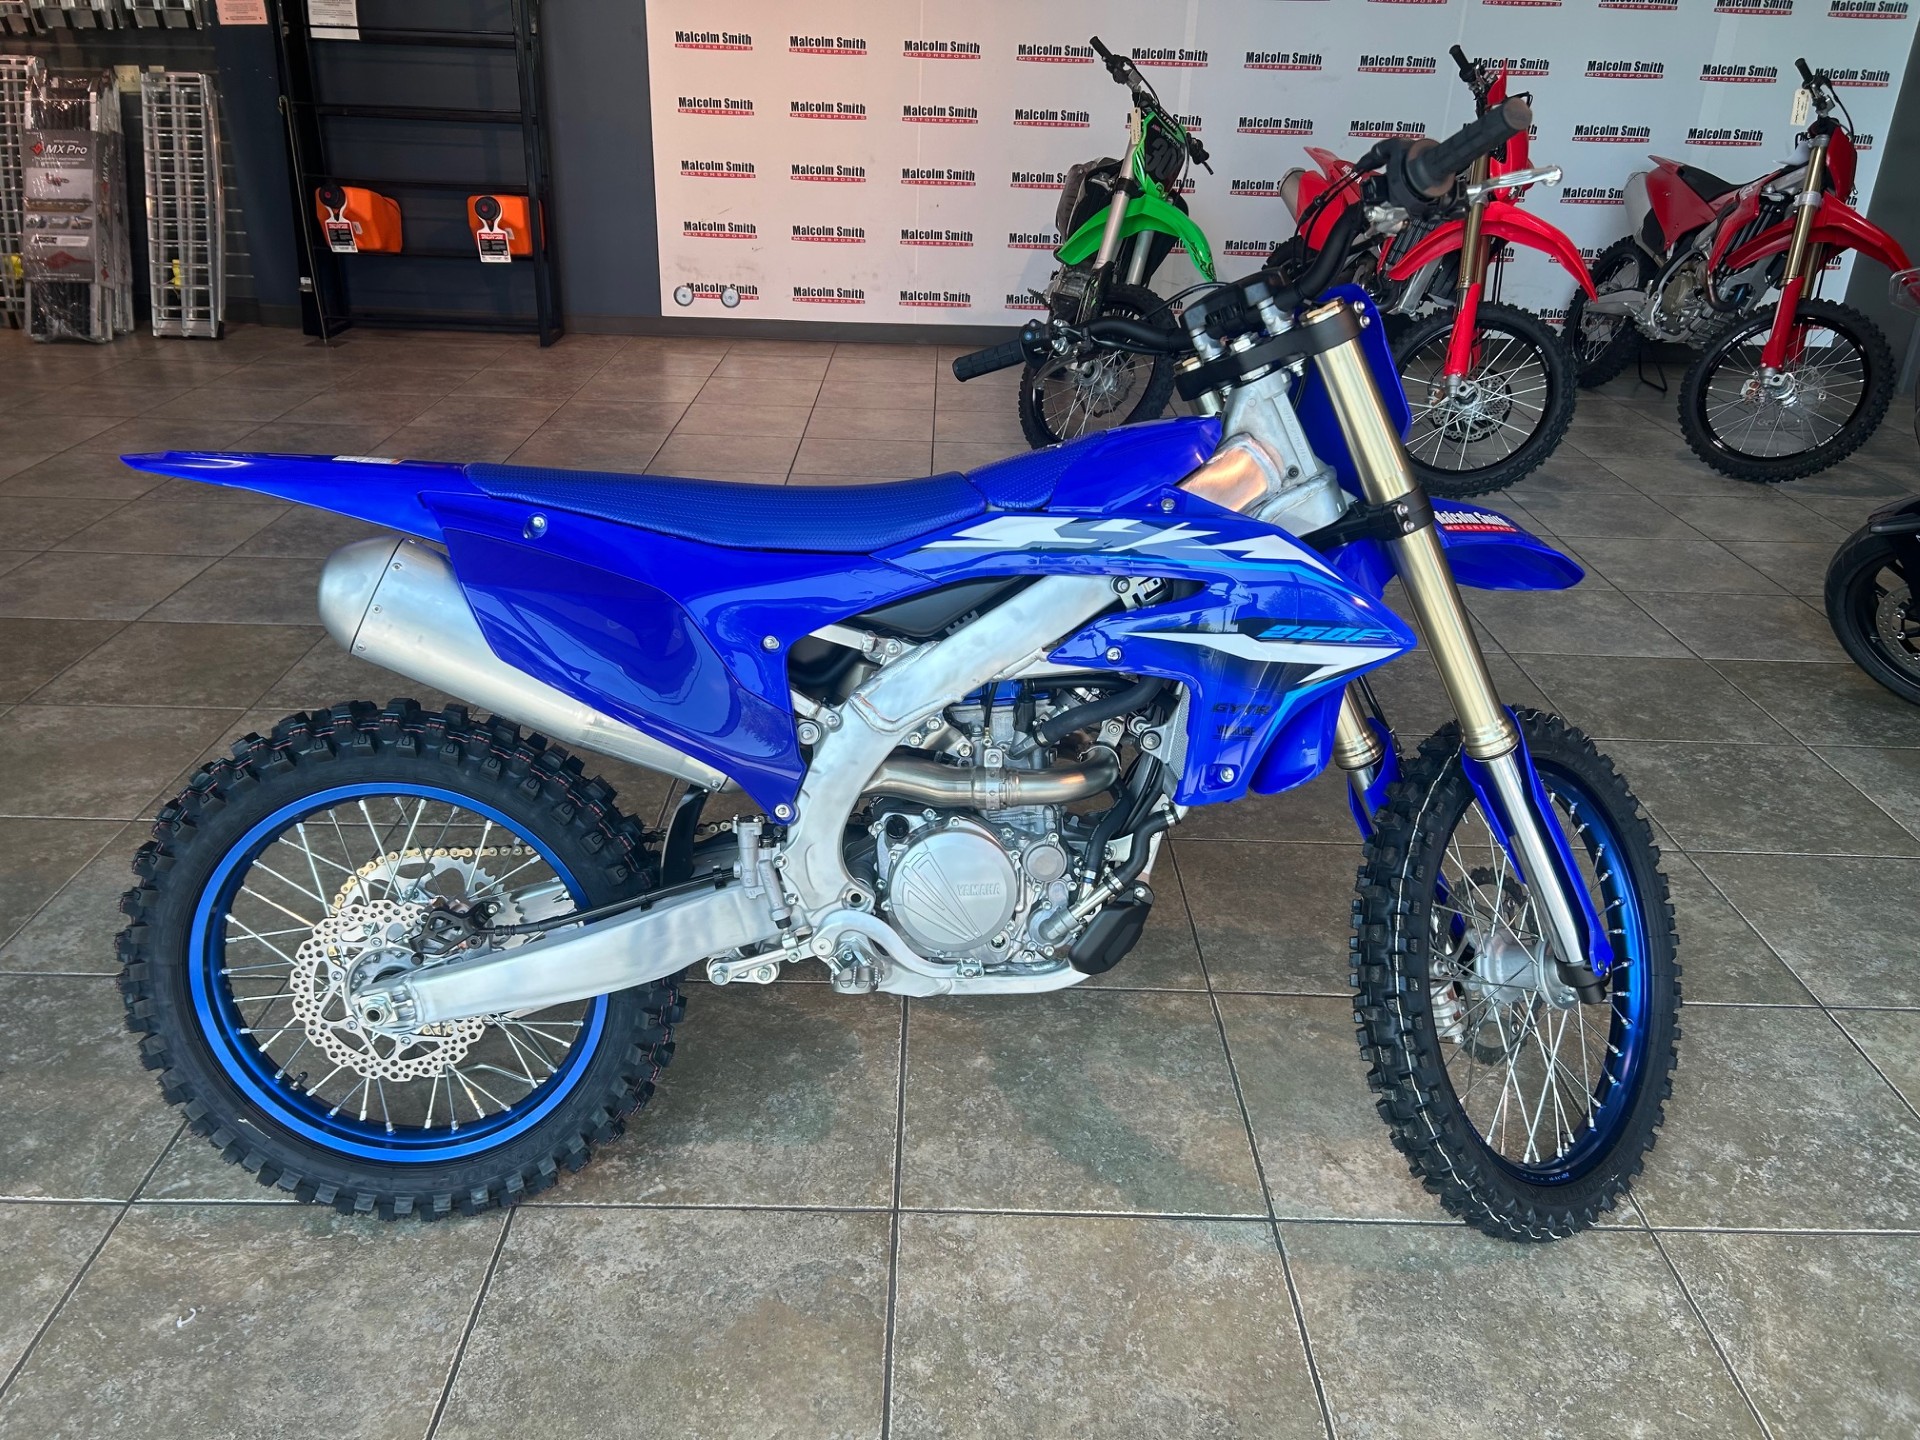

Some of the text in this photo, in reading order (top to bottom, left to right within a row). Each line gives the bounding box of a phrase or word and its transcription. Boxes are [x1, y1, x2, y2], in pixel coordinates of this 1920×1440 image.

[1763, 0, 1793, 9] Smith
[1831, 1, 1908, 13] Malcolm Smith
[676, 31, 752, 45] Malcolm Smith
[790, 36, 866, 49] Malcolm Smith
[675, 43, 753, 51] MOTORSPORTS
[789, 47, 867, 55] MOTORSPORTS
[904, 41, 980, 53] Malcolm Smith
[1018, 45, 1094, 57] Malcolm Smith
[1132, 48, 1208, 61] Malcolm Smith
[1246, 52, 1322, 65] Malcolm Smith
[1360, 55, 1436, 68] Malcolm Smith
[1520, 58, 1549, 70] Smith
[1587, 61, 1664, 73] Malcolm Smith
[1702, 65, 1778, 77] Malcolm Smith
[1860, 69, 1890, 81] Smith
[678, 97, 753, 110] Malcolm Smith
[791, 102, 865, 114] Malcolm Smith
[678, 108, 754, 116] MOTORSPORTS
[903, 106, 977, 118] Malcolm Smith
[1015, 109, 1089, 122] Malcolm Smith
[1239, 117, 1313, 129] Malcolm Smith
[1350, 121, 1425, 133] Malcolm Smith
[1575, 125, 1650, 137] Malcolm Smith
[1688, 128, 1763, 141] Malcolm Smith
[45, 145, 88, 154] MX Pro
[681, 161, 755, 173] Malcolm Smith
[791, 165, 865, 177] Malcolm Smith
[902, 169, 975, 181] Malcolm Smith
[1012, 172, 1054, 183] Malcolm
[1232, 180, 1274, 190] Malcolm
[1563, 188, 1606, 198] Malcolm
[684, 221, 756, 233] Malcolm Smith
[792, 226, 864, 238] Malcolm Smith
[901, 230, 972, 241] Malcolm Smith
[1009, 233, 1050, 243] Malcolm
[1225, 240, 1267, 250] Malcolm
[793, 287, 864, 299] Malcolm Smith
[900, 291, 970, 303] Malcolm Smith
[1006, 295, 1038, 304] Malco
[1540, 309, 1567, 319] Malco
[1473, 512, 1511, 527] Smith
[1256, 625, 1393, 642] 250F
[957, 883, 1000, 896] YAMAHA
